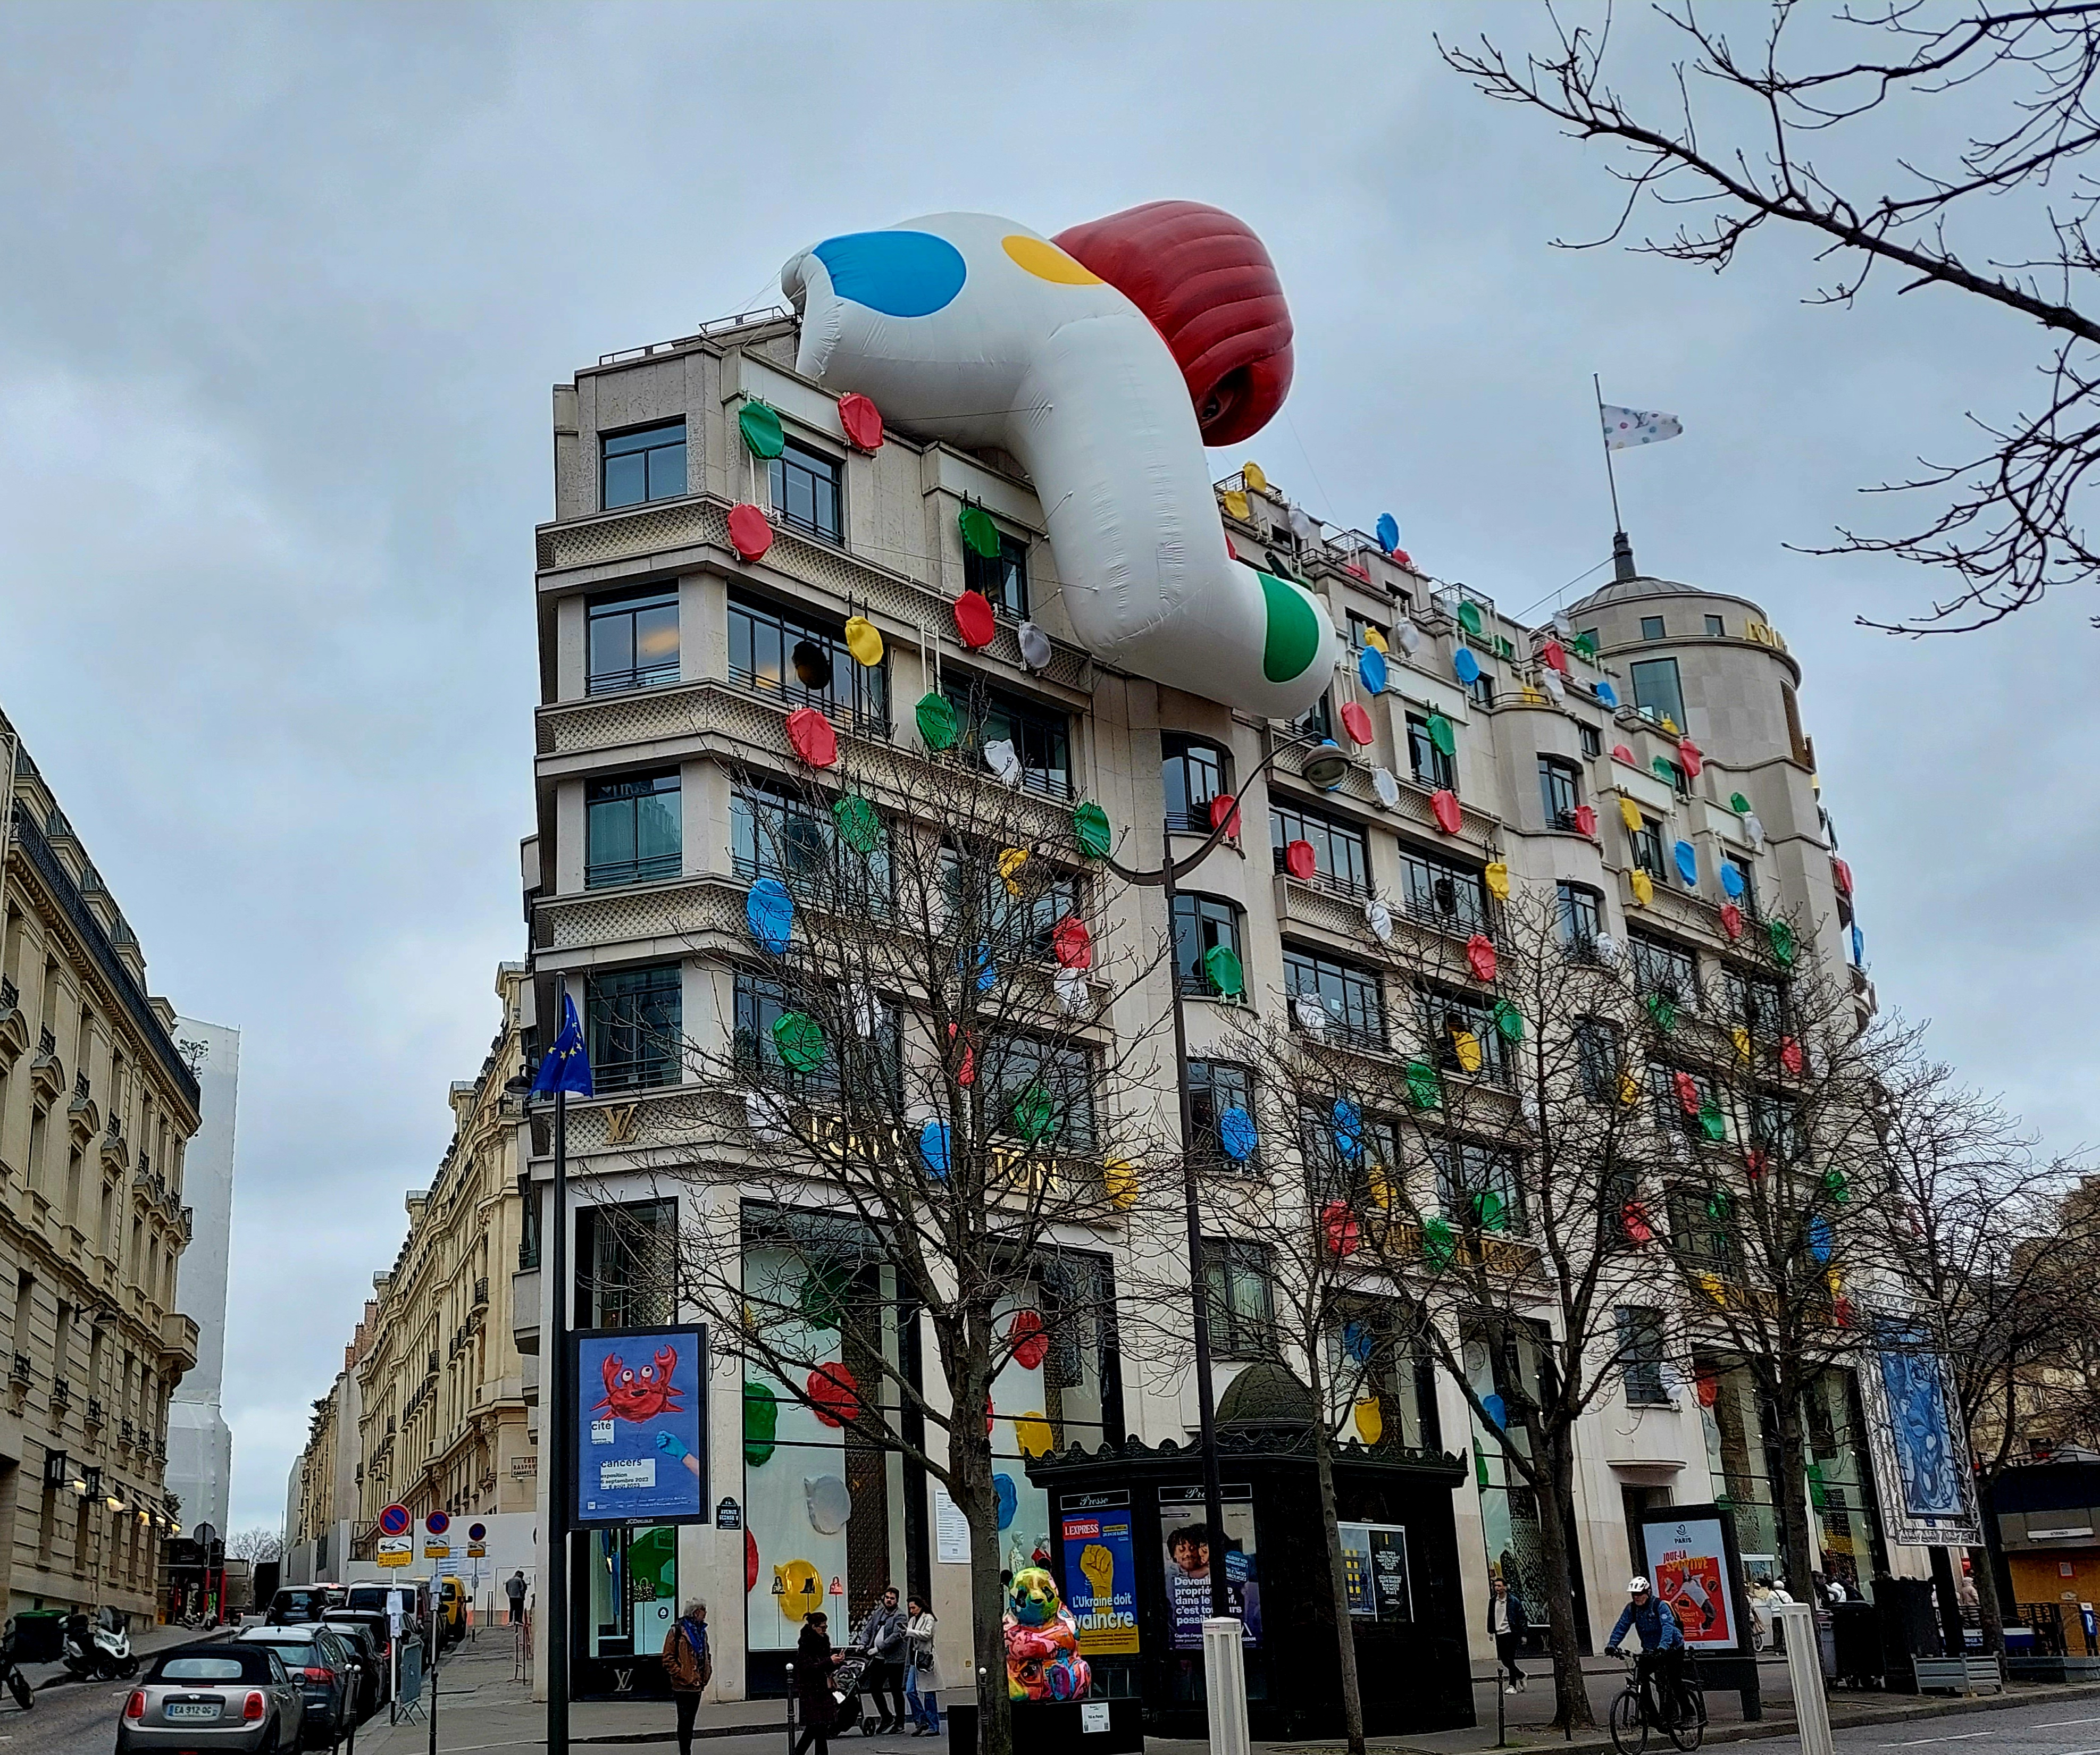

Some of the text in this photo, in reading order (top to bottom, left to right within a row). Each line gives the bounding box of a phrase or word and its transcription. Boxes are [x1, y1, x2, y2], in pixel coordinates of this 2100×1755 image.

[591, 1420, 611, 1430] cité
[601, 1459, 642, 1468] cancers
[1080, 1496, 1108, 1506] Presse
[1663, 1549, 1687, 1564] JOUE-LA
[1073, 1592, 1132, 1608] L'Ukraine doit
[1175, 1596, 1210, 1605] dans le
[1176, 1606, 1200, 1615] c'est
[1074, 1608, 1134, 1630] vaincre
